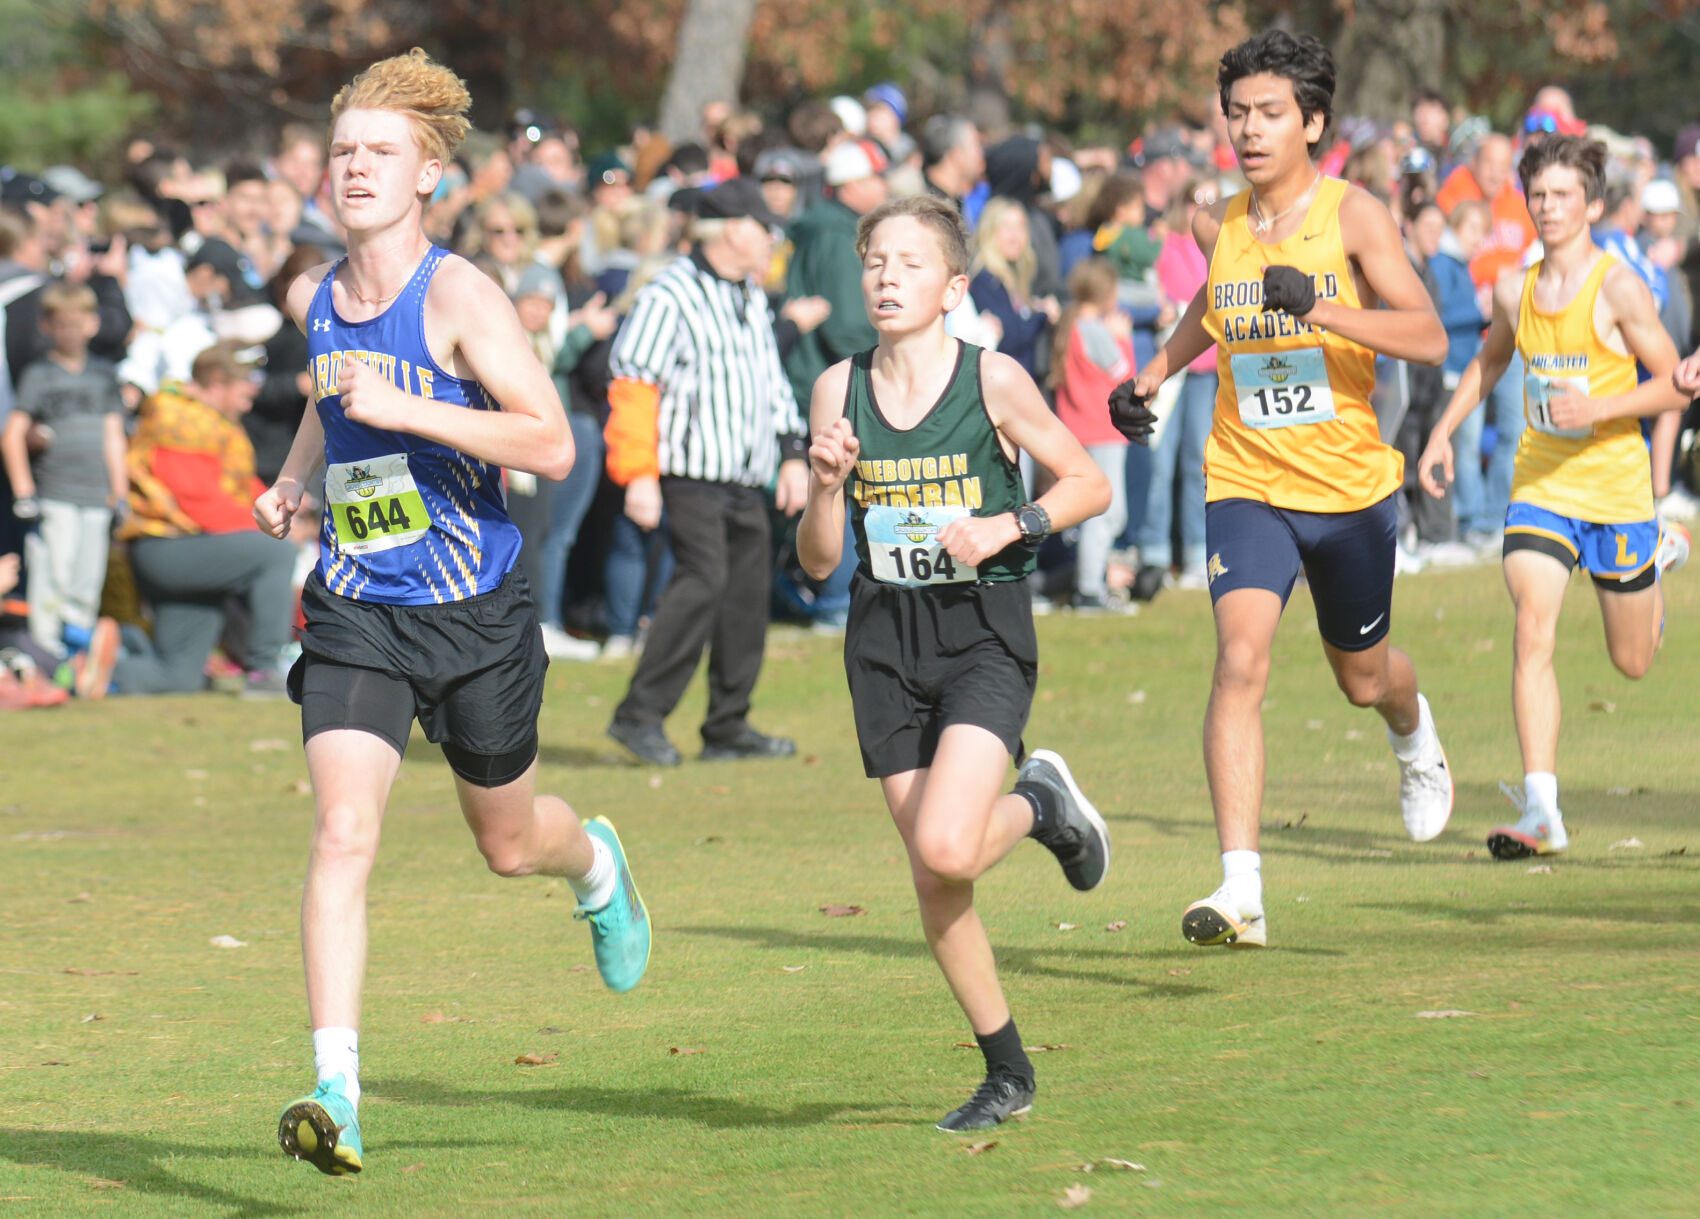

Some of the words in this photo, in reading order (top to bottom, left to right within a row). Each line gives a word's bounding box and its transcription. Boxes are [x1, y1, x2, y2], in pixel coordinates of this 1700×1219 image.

[1214, 273, 1338, 311] BROOLD
[1225, 311, 1327, 344] ACADEM
[1254, 385, 1315, 416] 152
[346, 498, 411, 539] 644
[889, 547, 956, 581] 164
[1615, 533, 1638, 566] L
